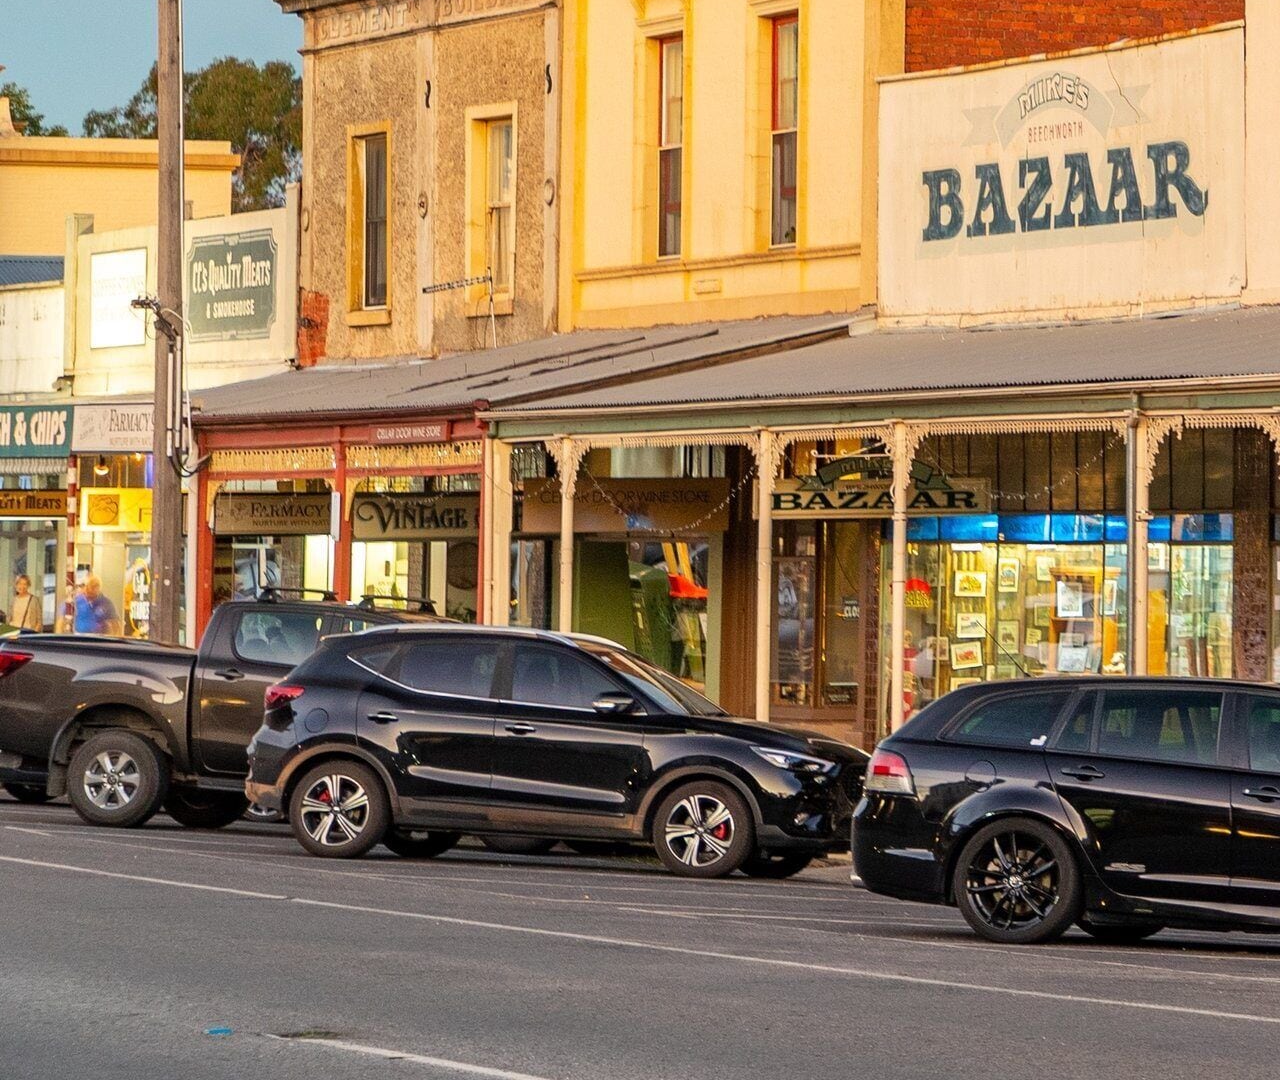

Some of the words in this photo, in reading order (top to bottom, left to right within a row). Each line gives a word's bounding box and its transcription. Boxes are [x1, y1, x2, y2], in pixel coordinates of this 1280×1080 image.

[1017, 72, 1090, 120] MIKE'S
[1027, 121, 1084, 143] BEECHWORTH
[922, 140, 1209, 243] BAZAAR
[213, 298, 255, 319] SMOKEHOUSE
[13, 411, 27, 446] &
[30, 410, 68, 446] CHIPS
[357, 500, 468, 533] VINTAGE
